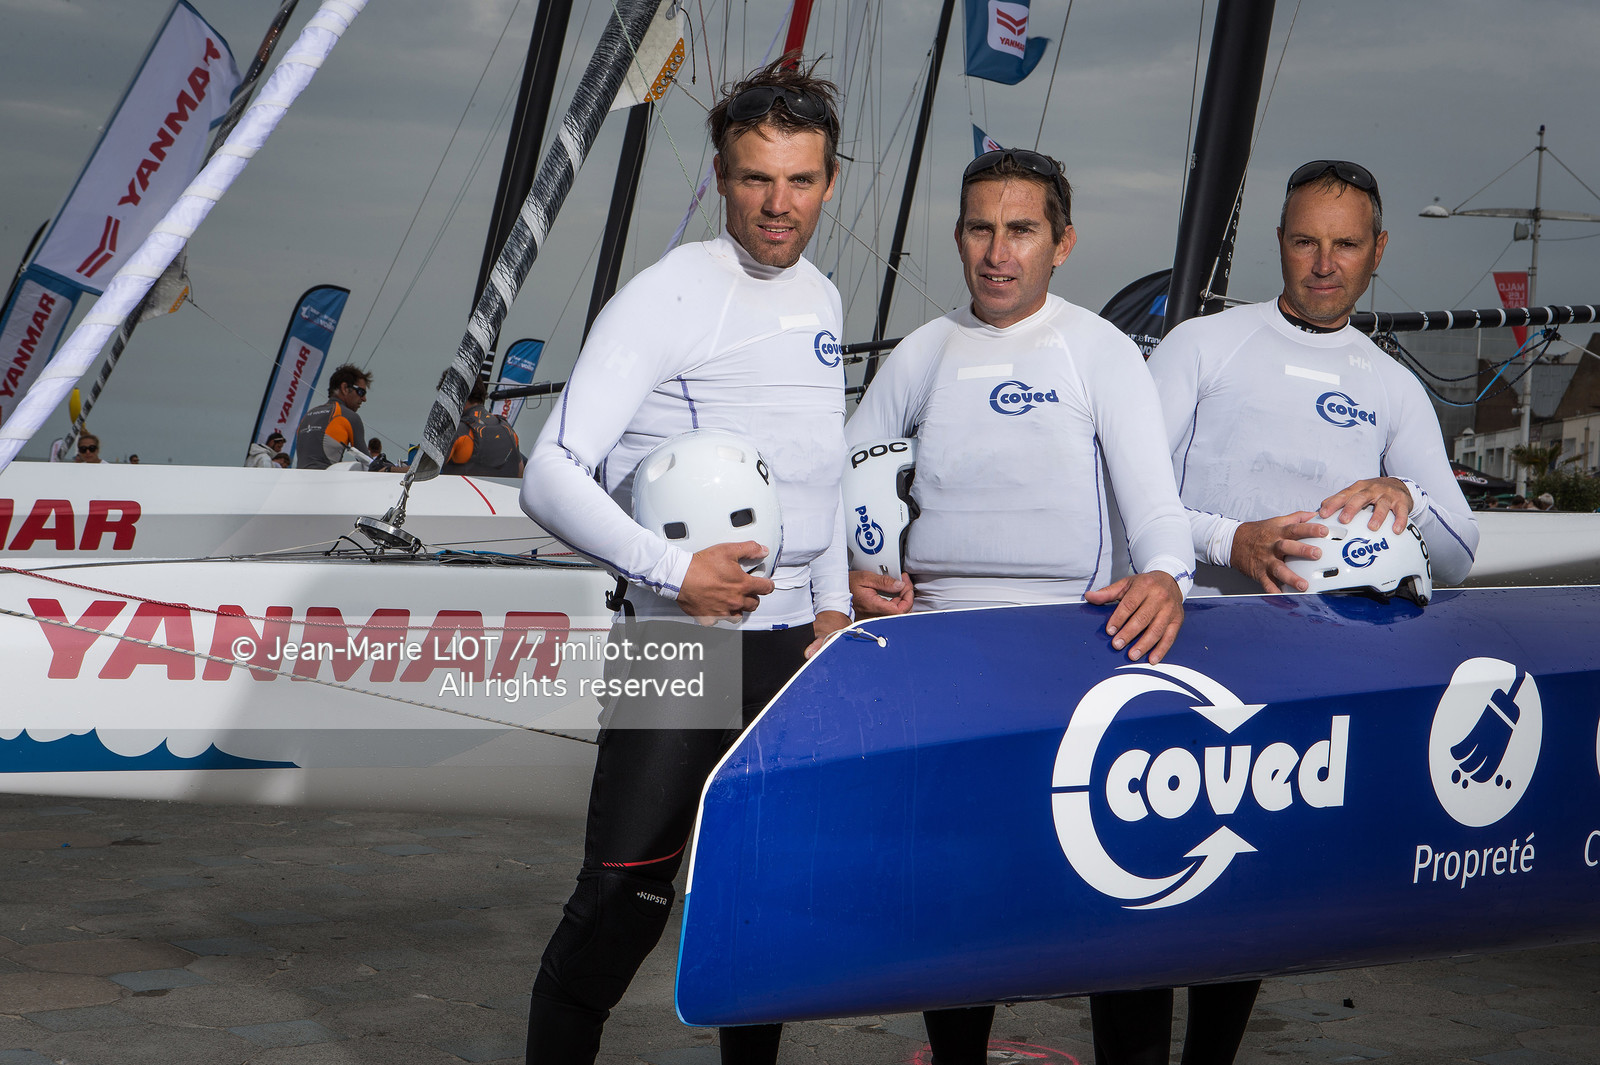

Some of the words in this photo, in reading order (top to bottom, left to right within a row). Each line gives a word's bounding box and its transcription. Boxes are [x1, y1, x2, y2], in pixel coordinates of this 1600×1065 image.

[0, 293, 56, 398] YANMAR
[277, 345, 311, 425] YANMAR
[999, 389, 1059, 405] coved
[1326, 401, 1377, 427] coved
[0, 498, 142, 551] AR
[854, 505, 876, 547] coved
[1350, 537, 1390, 559] coved
[27, 597, 571, 683] YANMAR
[1106, 714, 1350, 823] coved
[1413, 831, 1536, 889] Propreté
